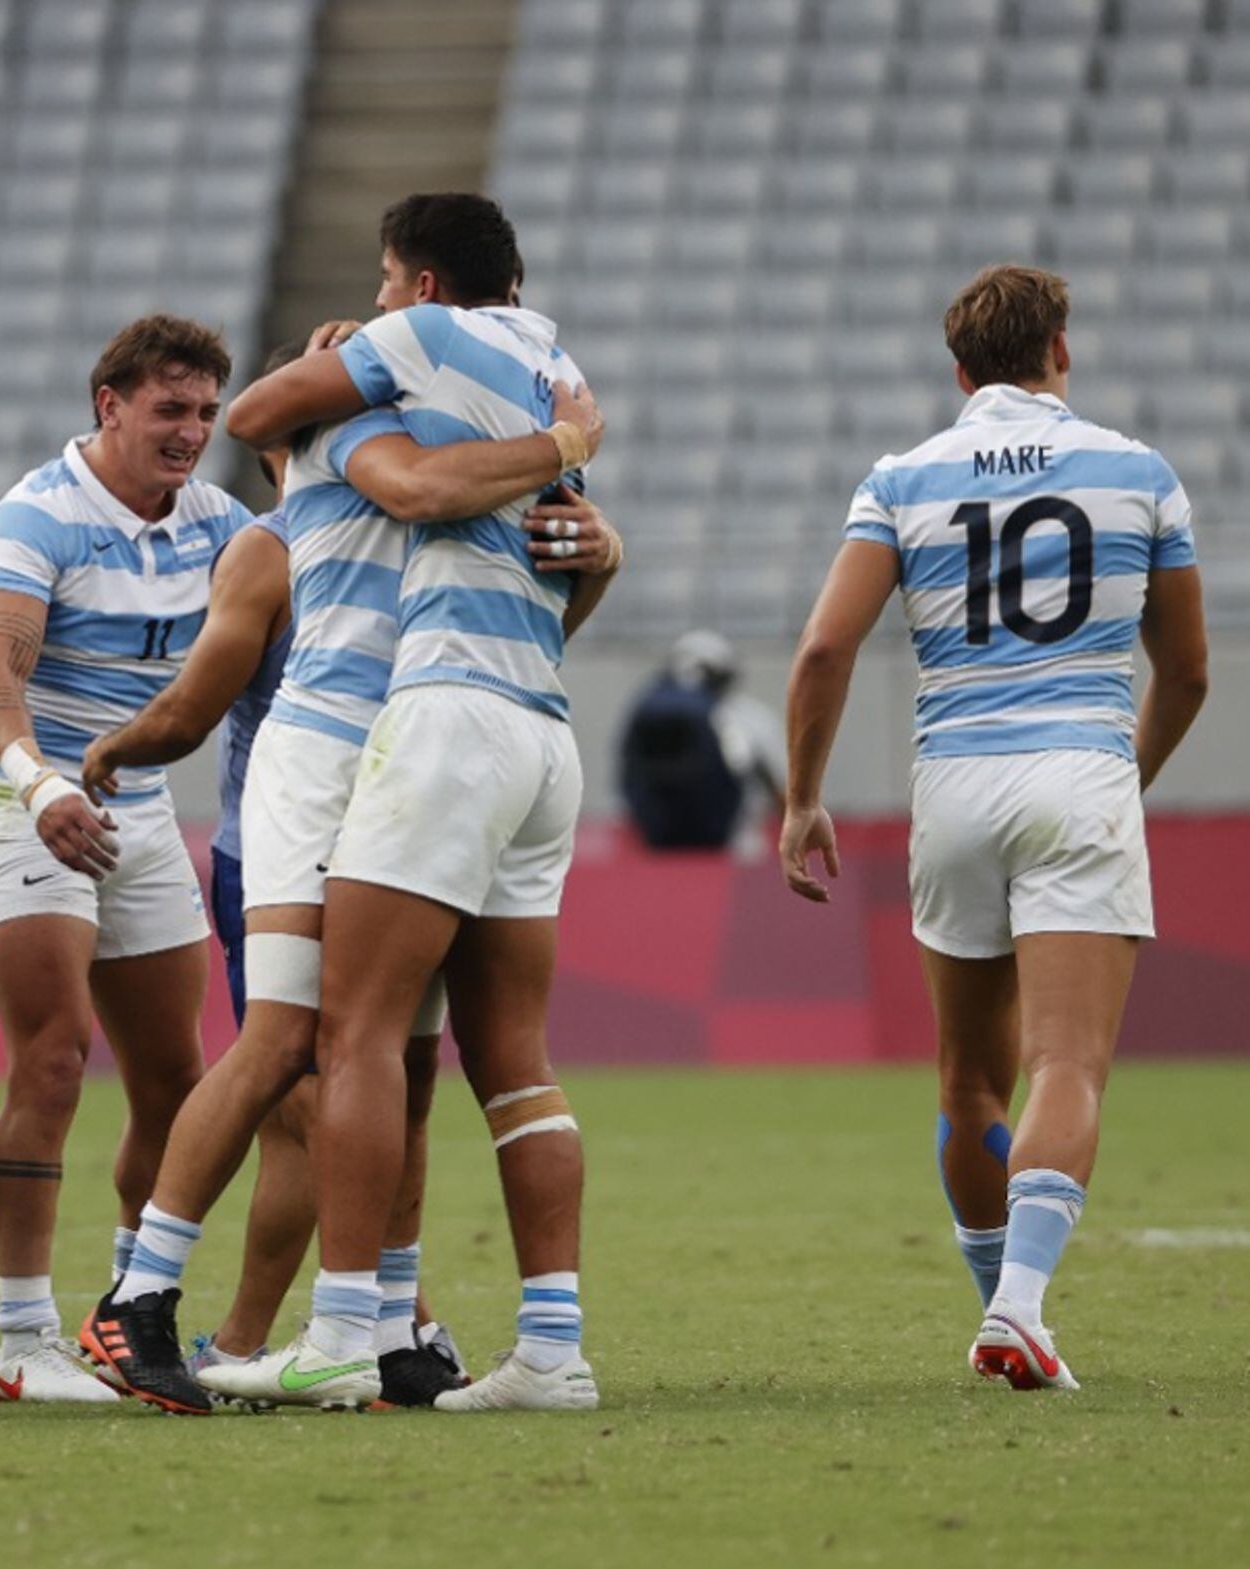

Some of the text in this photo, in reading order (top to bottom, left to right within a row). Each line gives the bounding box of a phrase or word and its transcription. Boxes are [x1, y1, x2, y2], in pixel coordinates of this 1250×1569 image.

[974, 445, 1054, 477] MARE
[949, 496, 1093, 645] 10
[140, 618, 175, 660] 11
